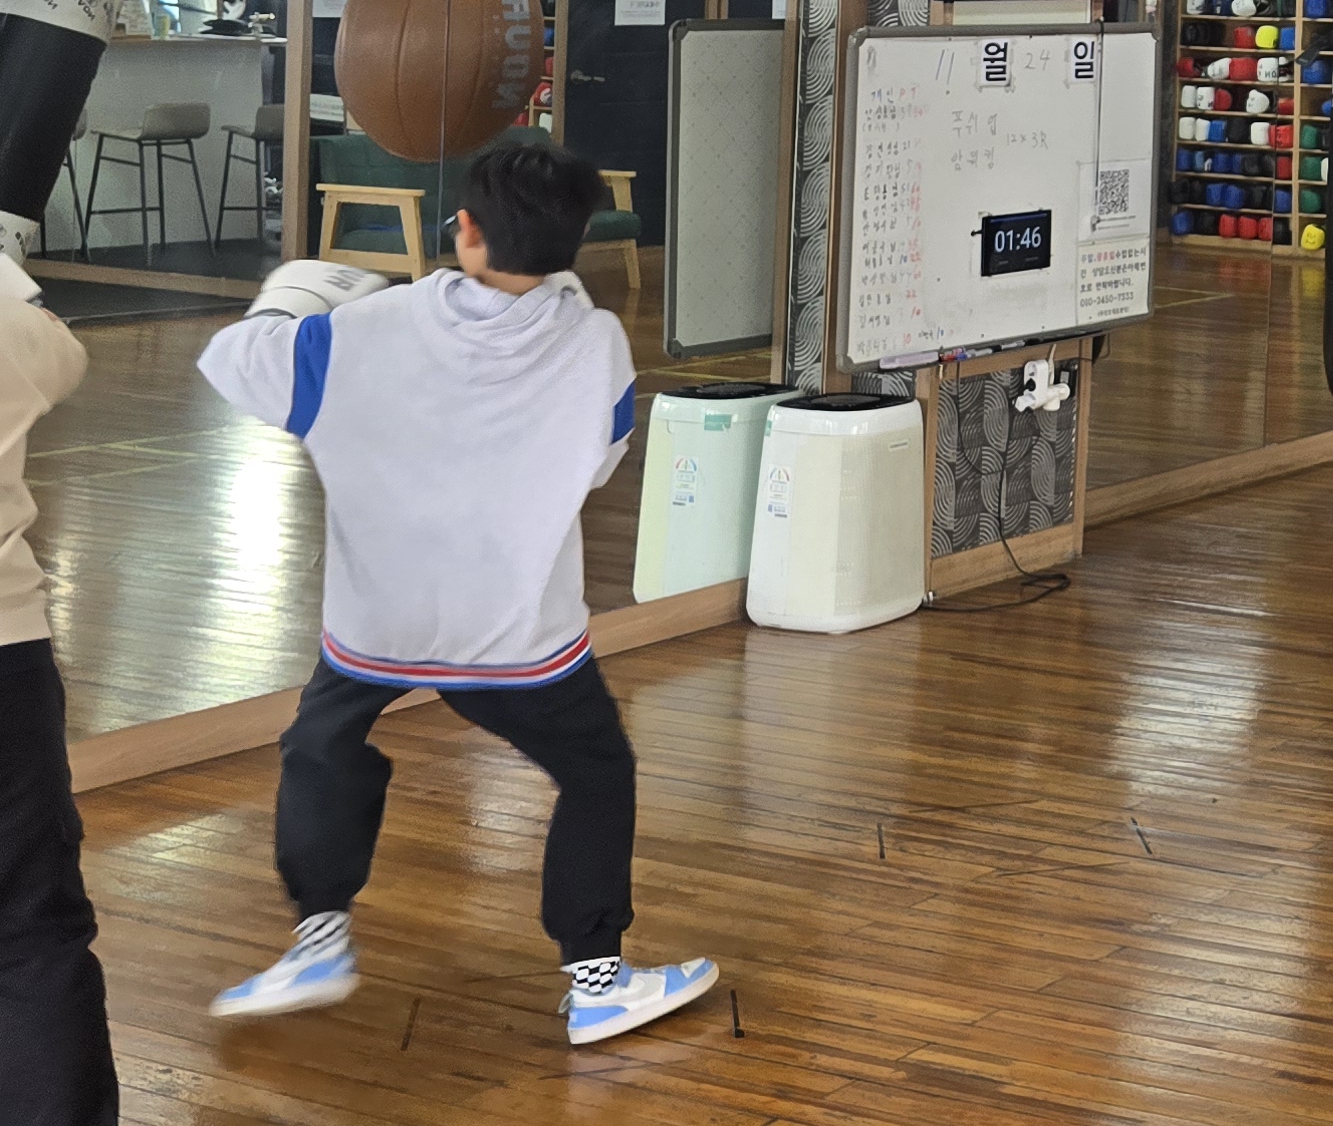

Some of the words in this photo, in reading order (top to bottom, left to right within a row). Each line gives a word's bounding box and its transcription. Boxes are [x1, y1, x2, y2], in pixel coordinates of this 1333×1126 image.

[982, 41, 1009, 82] 월
[1024, 48, 1051, 72] 24
[1073, 40, 1096, 80] 일
[995, 226, 1041, 252] 01:46
